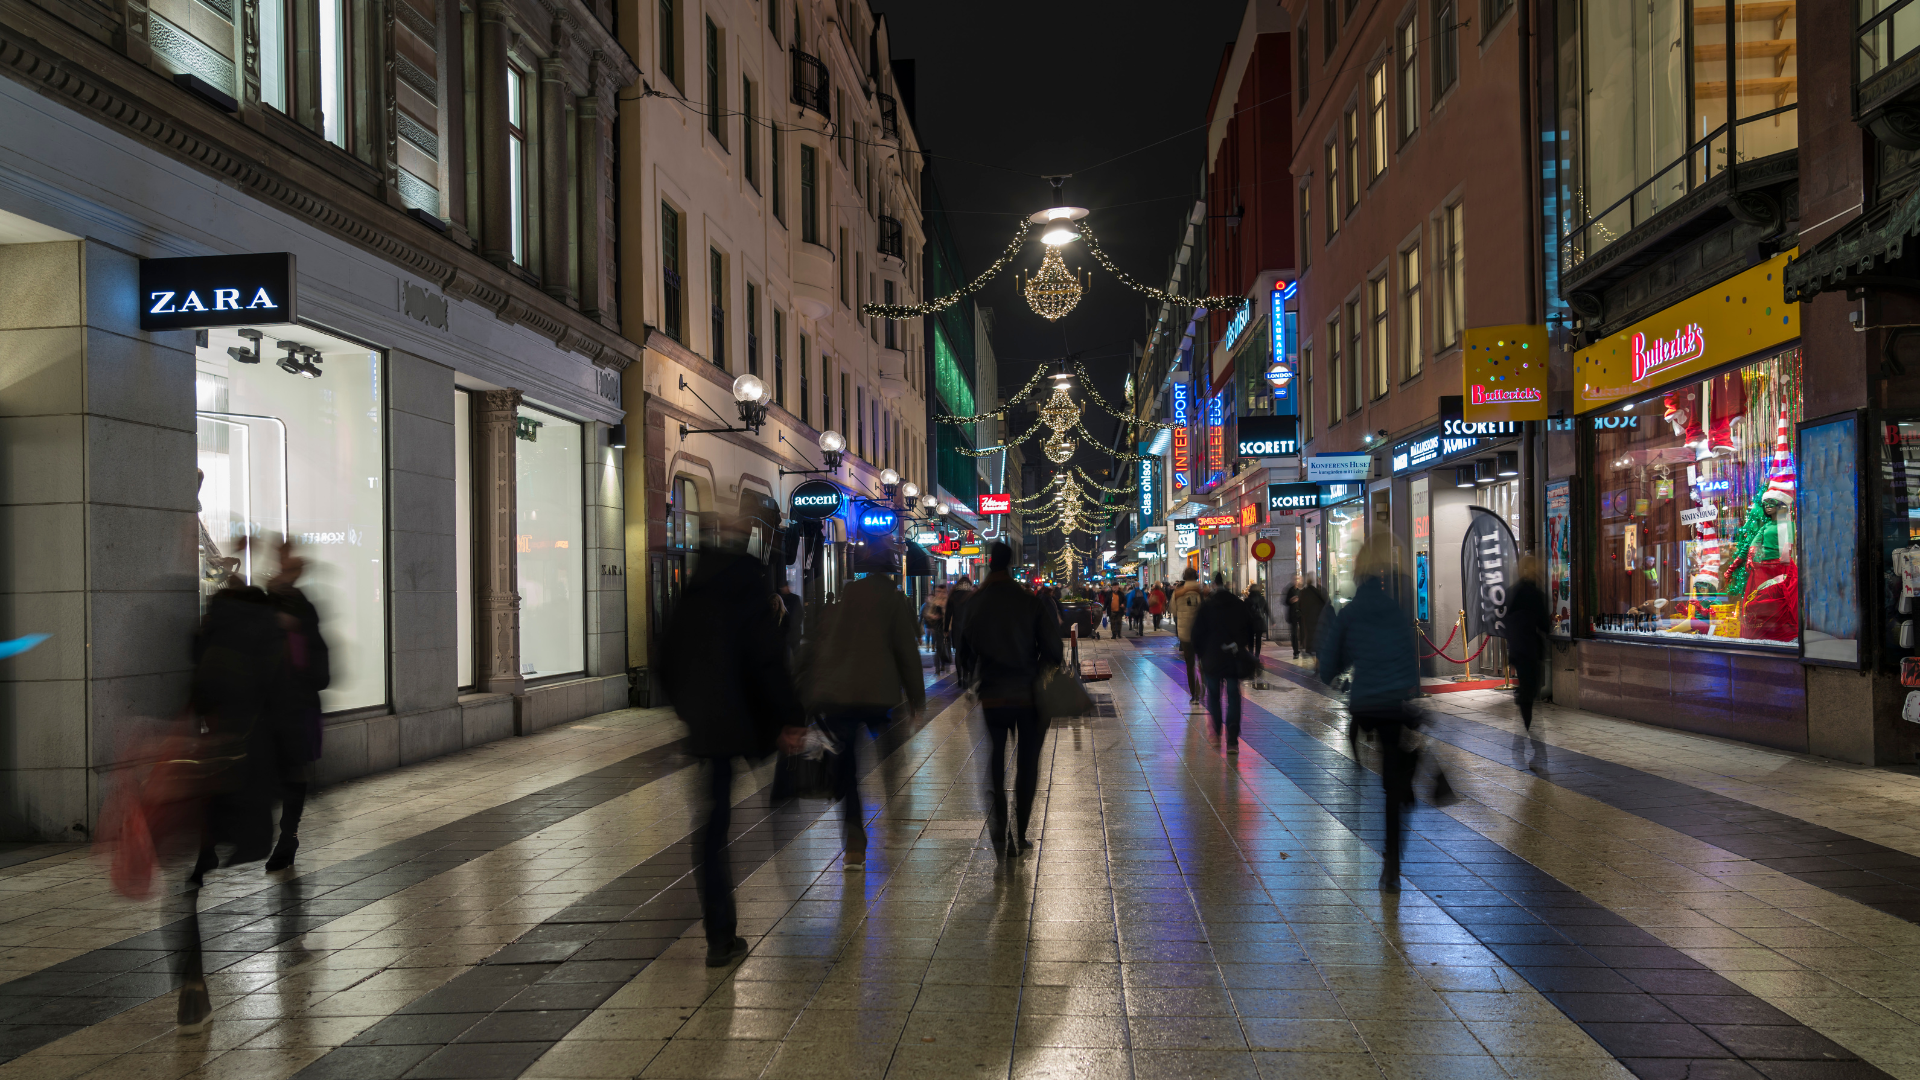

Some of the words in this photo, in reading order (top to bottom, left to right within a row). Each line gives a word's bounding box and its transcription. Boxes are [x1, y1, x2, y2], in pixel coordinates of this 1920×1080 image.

[150, 287, 278, 313] ZARA
[1274, 292, 1283, 362] RESTAURANG
[1631, 322, 1704, 383] Butterick's
[1471, 384, 1542, 405] Butterick's
[1174, 382, 1188, 471] INTERSPORT
[1240, 440, 1295, 455] SCORETT
[795, 494, 838, 506] accent
[1141, 493, 1152, 516] clas
[1272, 494, 1317, 508] SCORETT
[864, 516, 893, 526] SALT
[1681, 511, 1700, 521] SANTA'S
[1700, 509, 1716, 519] LOUNGE
[601, 564, 623, 576] ZARA
